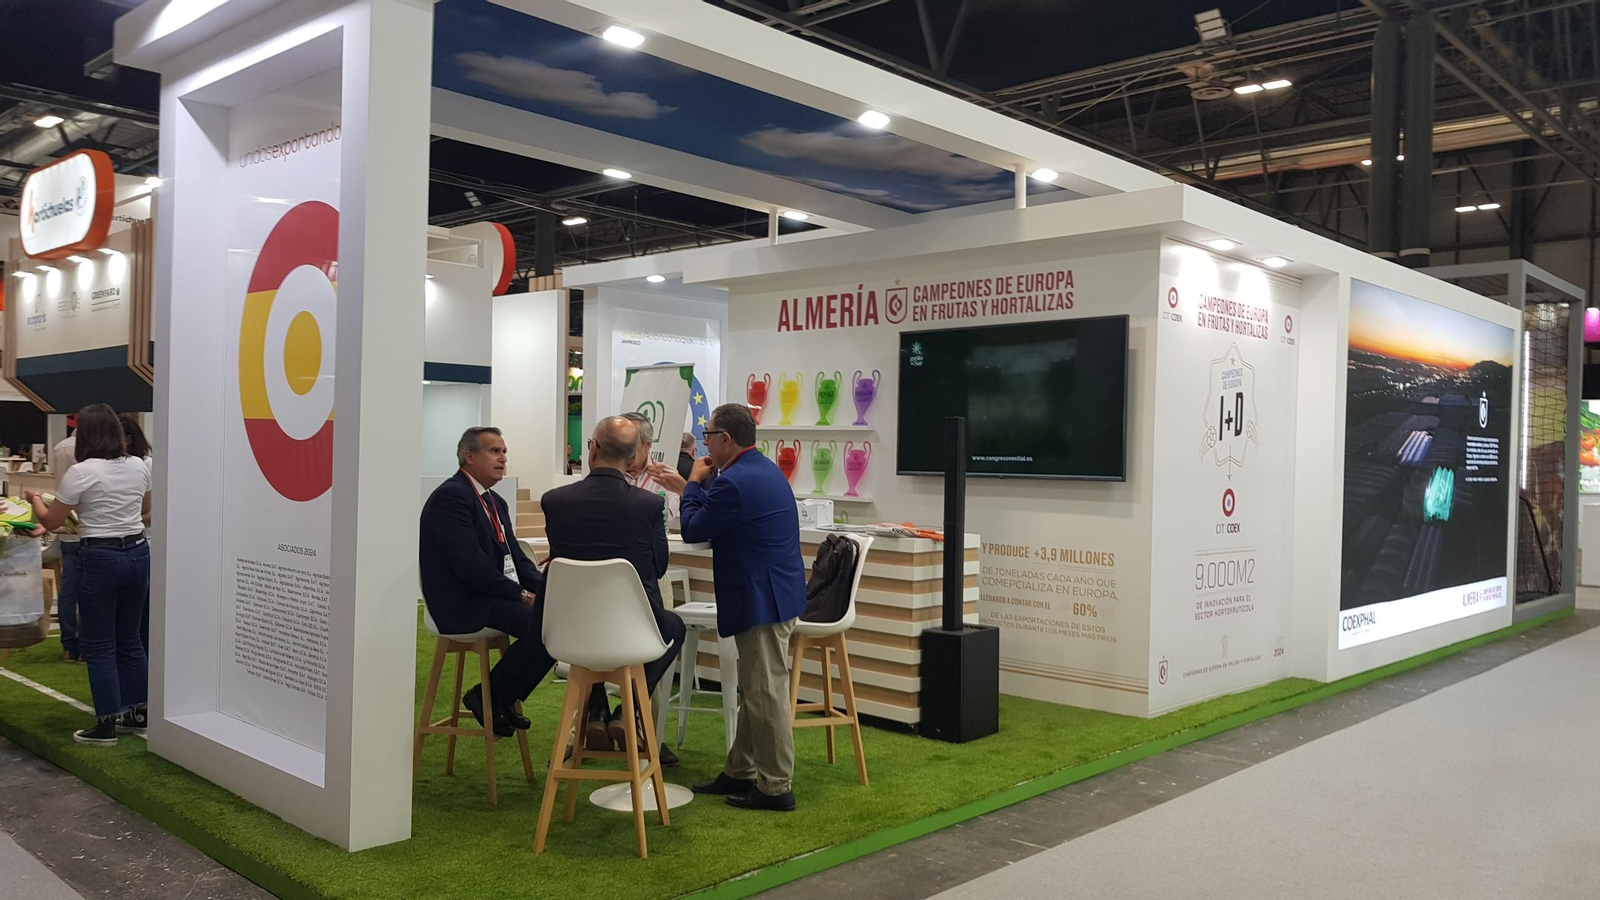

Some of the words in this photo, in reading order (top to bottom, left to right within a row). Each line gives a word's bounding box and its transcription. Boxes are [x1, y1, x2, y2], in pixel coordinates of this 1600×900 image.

[913, 278, 992, 304] CAMPEONES
[996, 276, 1013, 295] DE
[1016, 270, 1074, 294] EUROPA
[777, 283, 880, 332] ALMERÍA
[912, 303, 928, 322] EN
[931, 298, 978, 320] FRUTAS
[980, 298, 989, 316] Y
[990, 291, 1074, 316] HORTALIZAS
[1198, 312, 1206, 328] EN
[1207, 314, 1229, 332] FRUTAS
[1230, 318, 1234, 333] Y
[1234, 319, 1268, 340] HORTALIZAS
[1219, 392, 1244, 441] I+D
[1216, 524, 1225, 534] CIT
[1227, 523, 1240, 534] COEX
[278, 544, 303, 555] ASOCIADOS
[304, 548, 316, 557] 2024
[982, 542, 987, 554] Y
[988, 543, 1030, 558] PRODUCE
[1034, 547, 1057, 563] +3,9
[1060, 548, 1115, 567] MILLONES
[982, 566, 993, 574] DE
[995, 567, 1045, 580] TONELADAS
[1047, 573, 1072, 583] CADA
[1074, 575, 1094, 585] AÑO
[1097, 579, 1116, 588] QUE
[1196, 558, 1255, 590] 9.000M2
[1056, 586, 1070, 595] EN
[980, 594, 1006, 604] LLEGANDO
[1011, 597, 1032, 607] CONTAR
[1032, 599, 1044, 608] CON
[1045, 602, 1051, 610] EL
[1073, 602, 1098, 618] 60%
[1014, 615, 1070, 628] EXPORTACIONES
[1082, 624, 1105, 633] ESTOS
[1342, 611, 1376, 631] COEXPHAL
